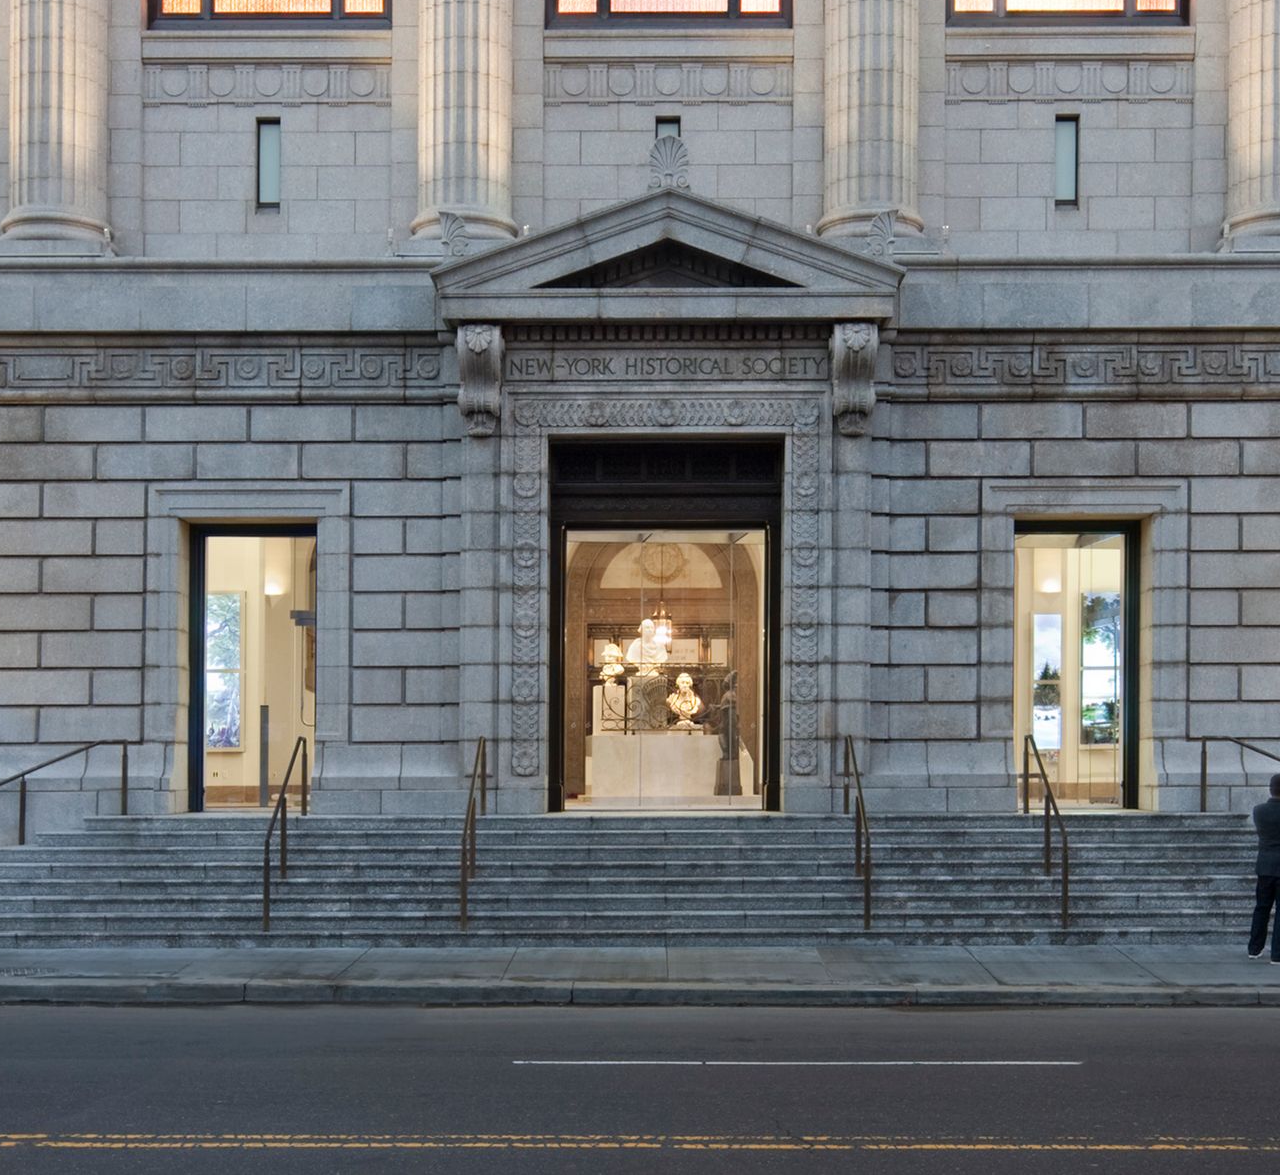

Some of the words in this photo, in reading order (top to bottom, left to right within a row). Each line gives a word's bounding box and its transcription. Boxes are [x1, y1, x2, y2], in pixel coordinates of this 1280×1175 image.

[509, 357, 615, 376] NEW-YORK
[625, 357, 733, 376] HISTORICAL
[741, 357, 826, 376] SOCIETY
